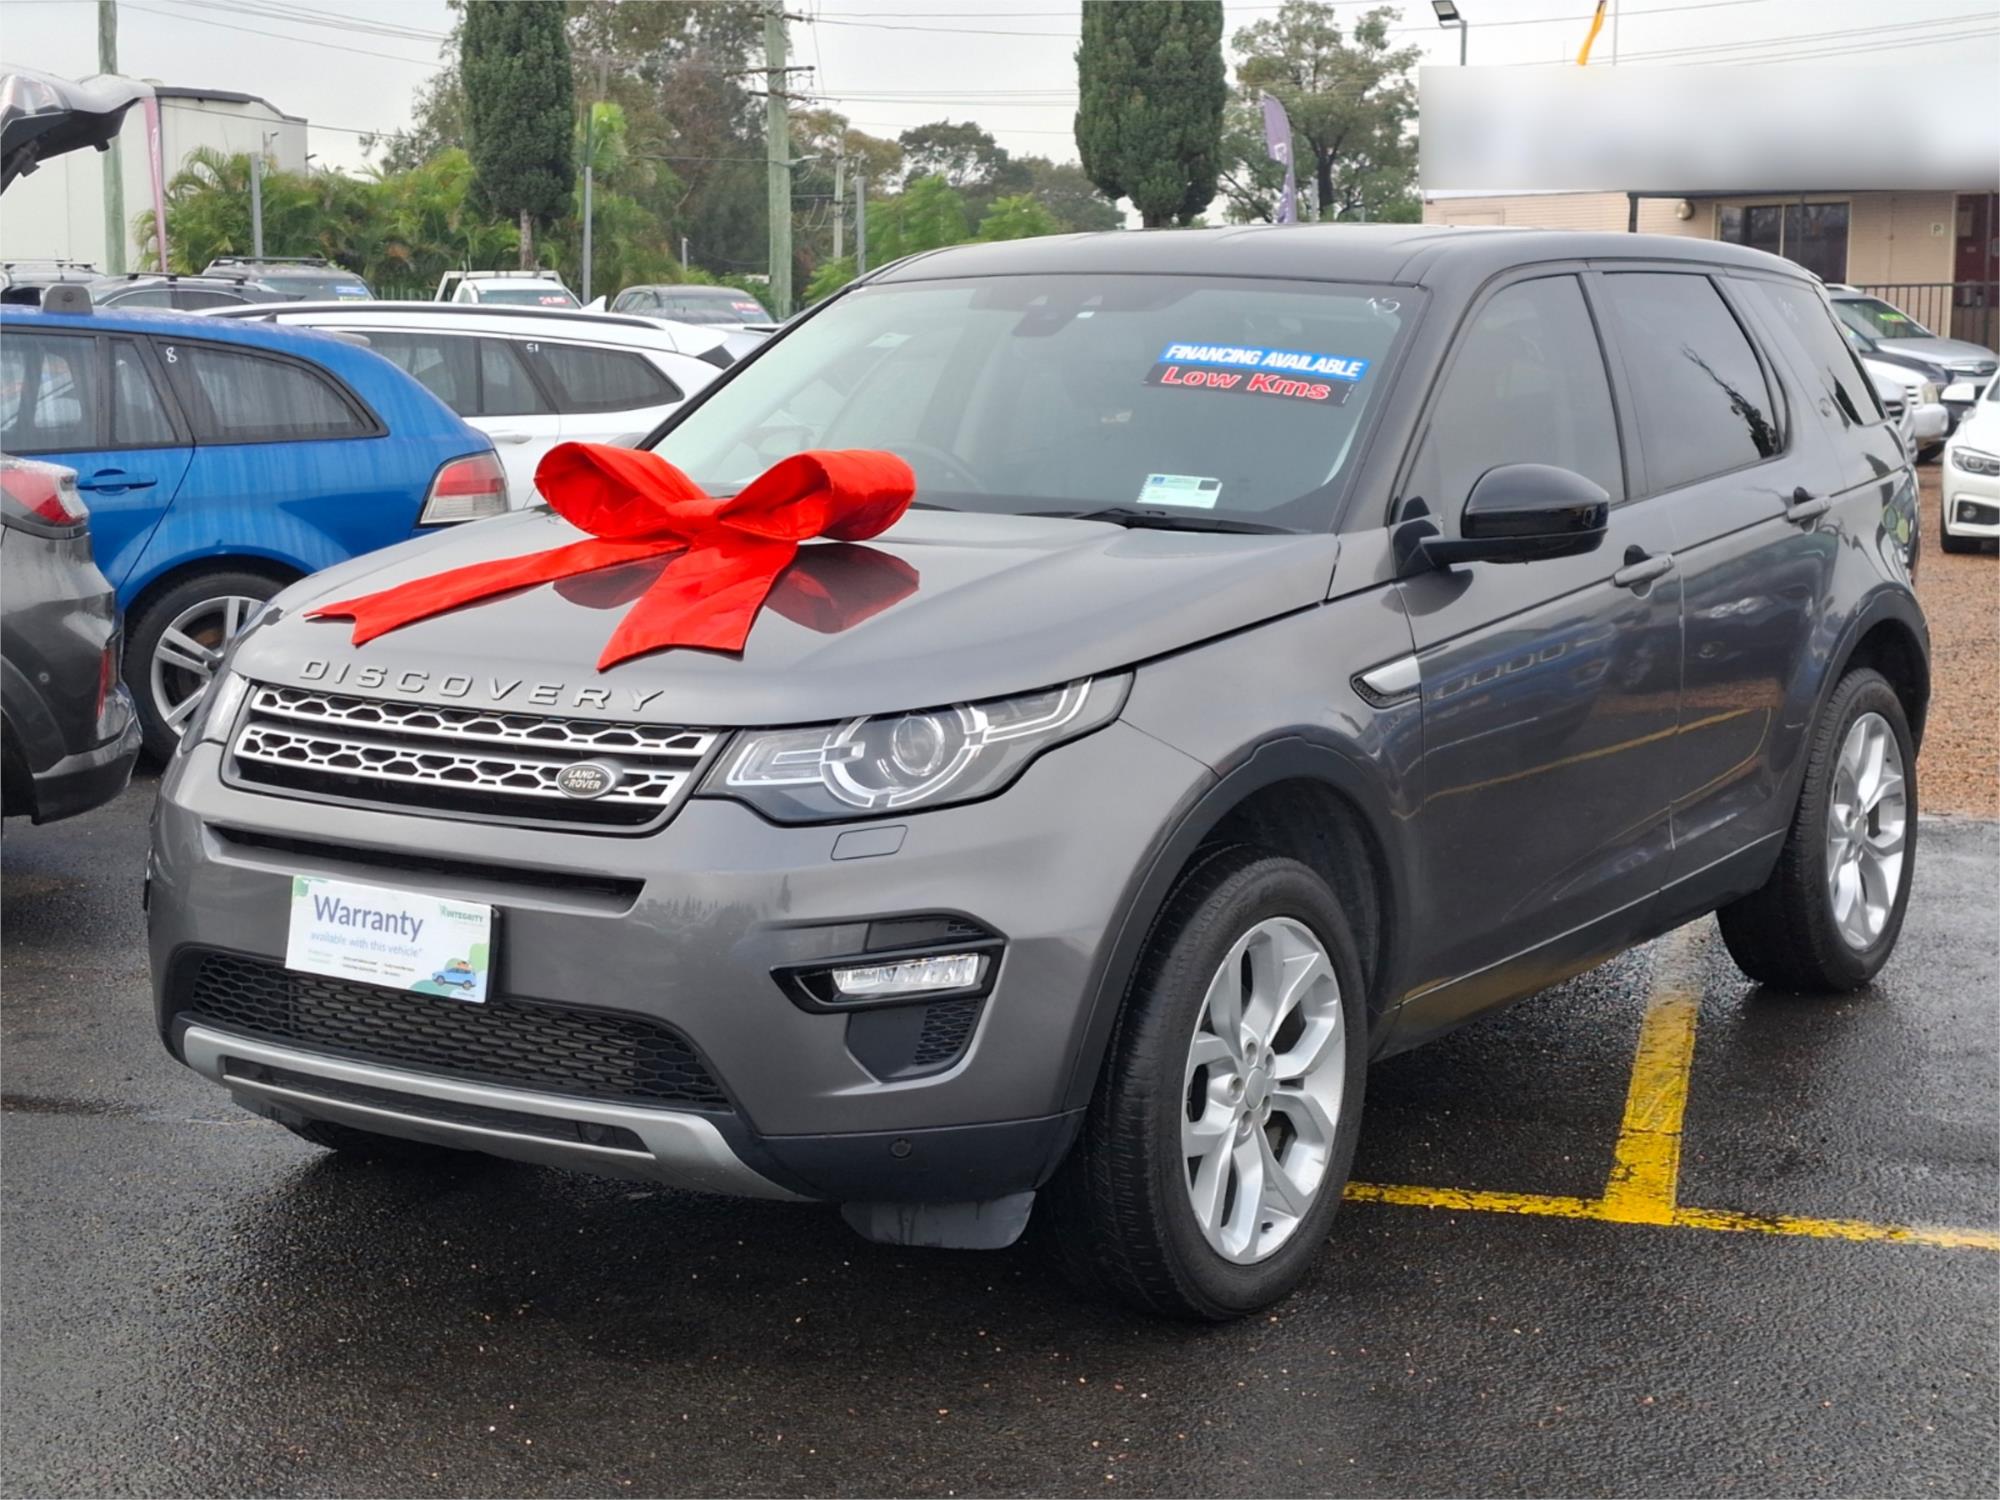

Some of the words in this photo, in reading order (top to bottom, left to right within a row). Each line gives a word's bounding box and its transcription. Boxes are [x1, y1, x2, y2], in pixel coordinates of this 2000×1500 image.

[166, 346, 177, 363] 8
[1165, 343, 1261, 366] FINANCING
[1262, 351, 1363, 377] AVAILABLE
[1161, 366, 1242, 389] Low
[1247, 373, 1332, 400] Kms
[299, 658, 665, 713] DISCOVERY
[567, 778, 602, 791] ROVER
[568, 769, 596, 780] LAND
[314, 894, 424, 943] Warranty
[310, 931, 347, 945] available
[348, 938, 369, 949] with
[369, 941, 387, 952] this
